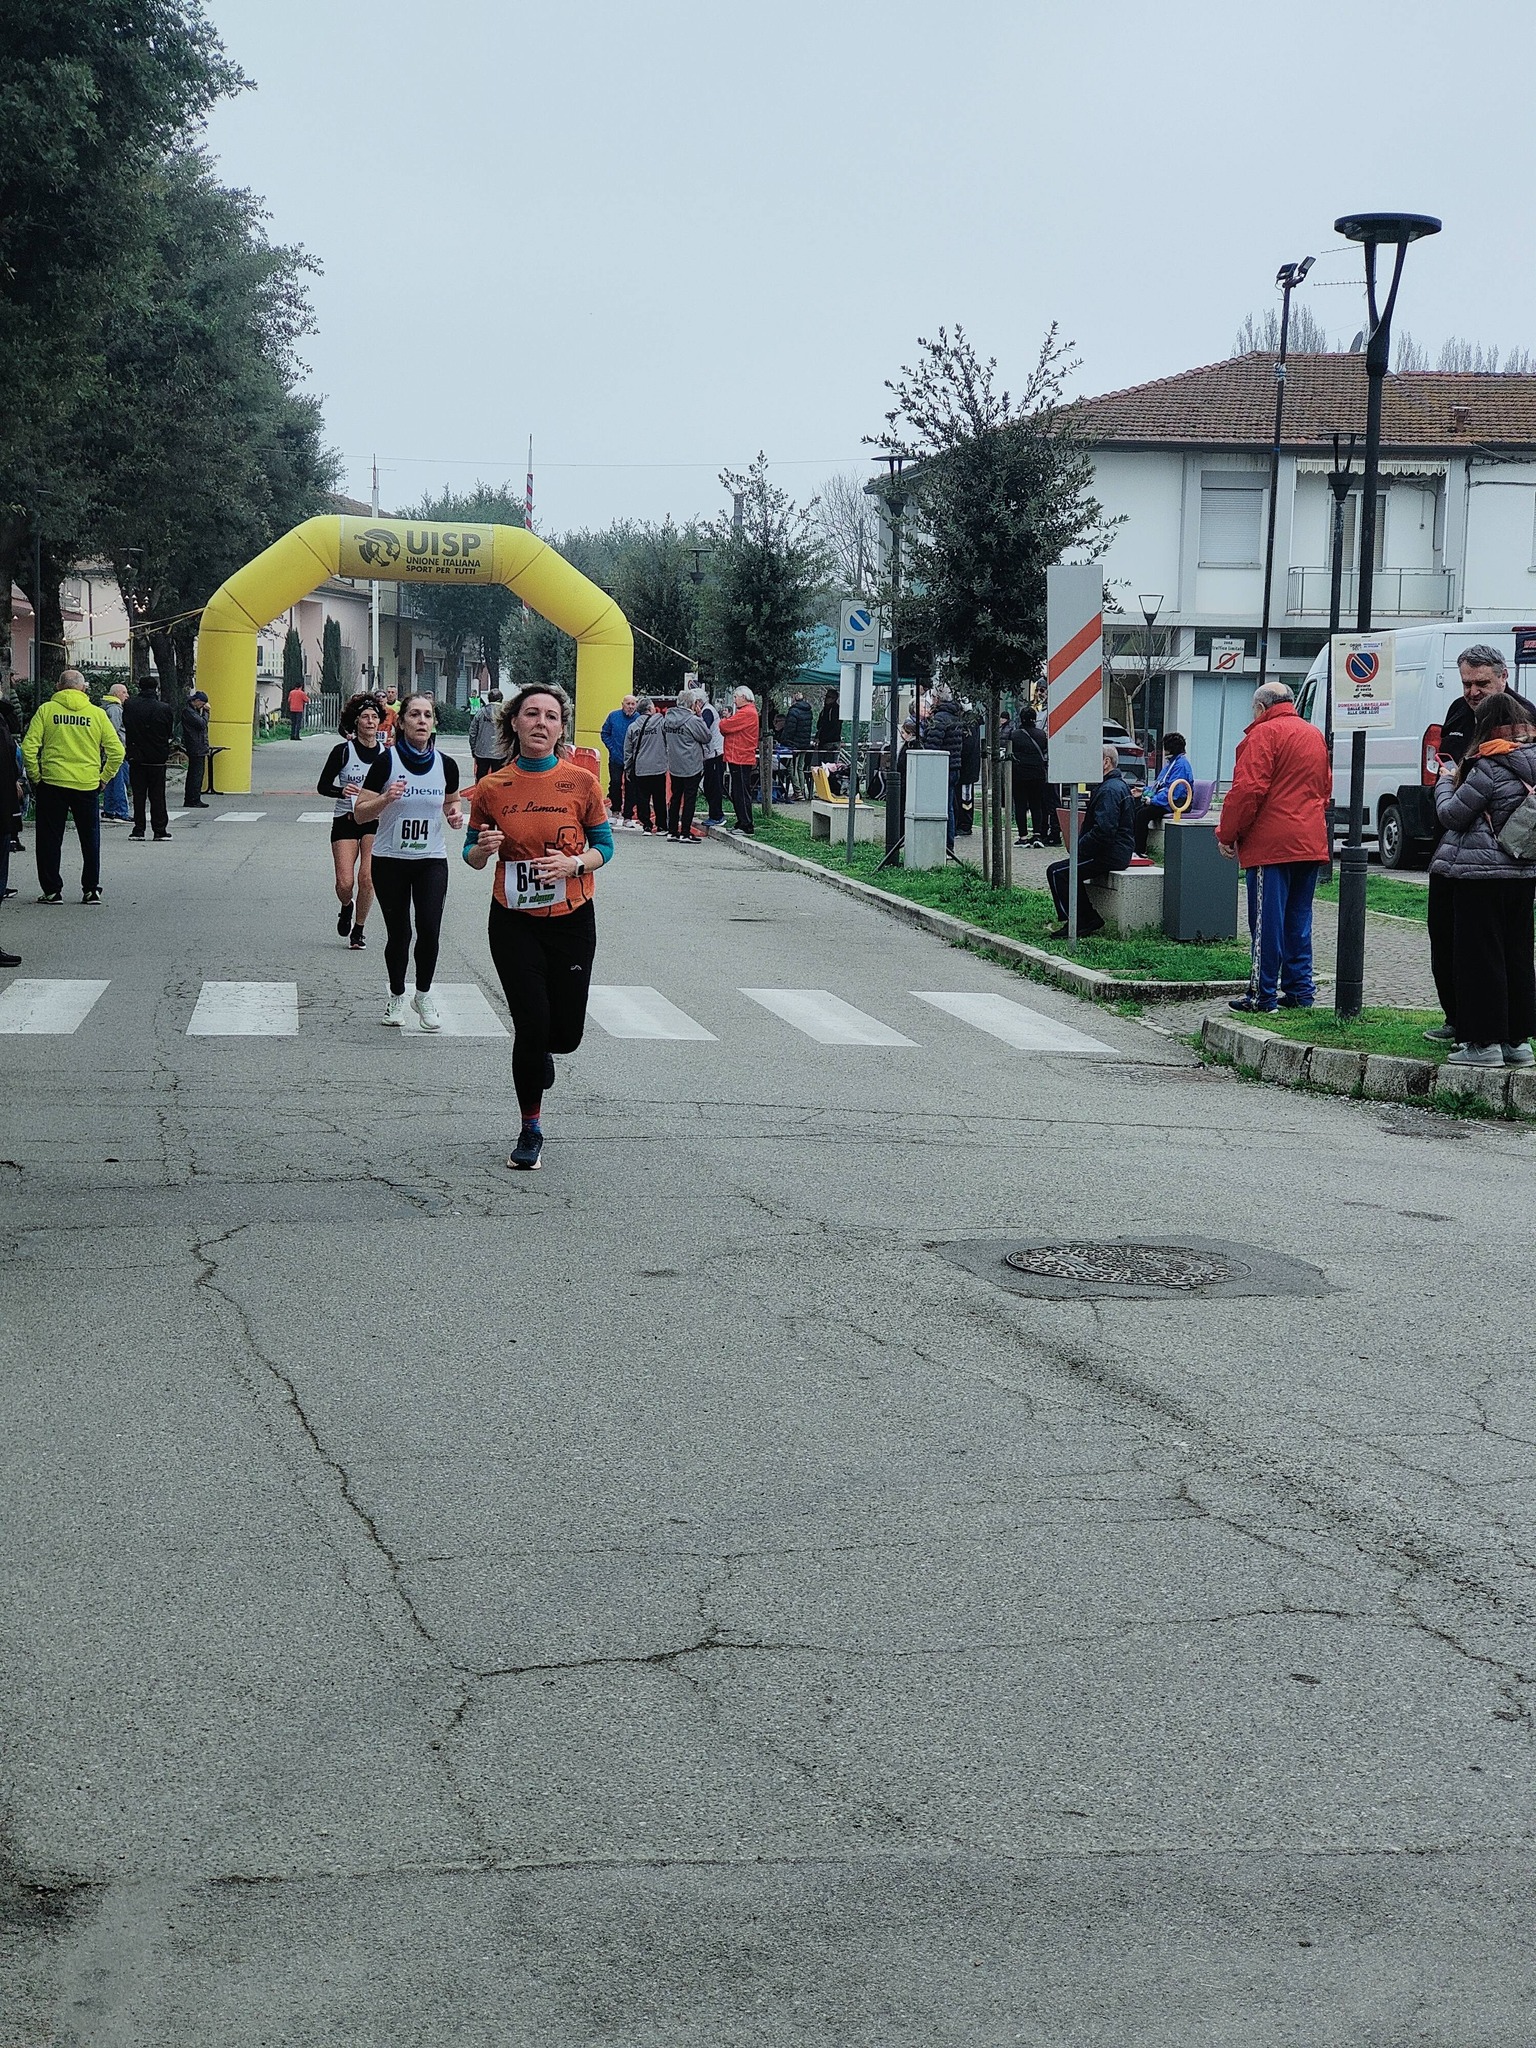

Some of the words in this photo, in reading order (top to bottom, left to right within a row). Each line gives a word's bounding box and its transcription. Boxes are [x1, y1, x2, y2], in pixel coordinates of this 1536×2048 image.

[406, 530, 481, 557] UISP
[406, 556, 439, 566] UNIONE
[443, 558, 481, 568] ITALIANA
[405, 565, 432, 573] SPORT
[436, 566, 451, 574] PER
[454, 567, 476, 575] TUTTI
[844, 640, 853, 650] P
[53, 714, 91, 727] GIUDICE
[502, 804, 519, 817] G.S.
[522, 801, 568, 814] Lamone
[401, 820, 429, 840] 604
